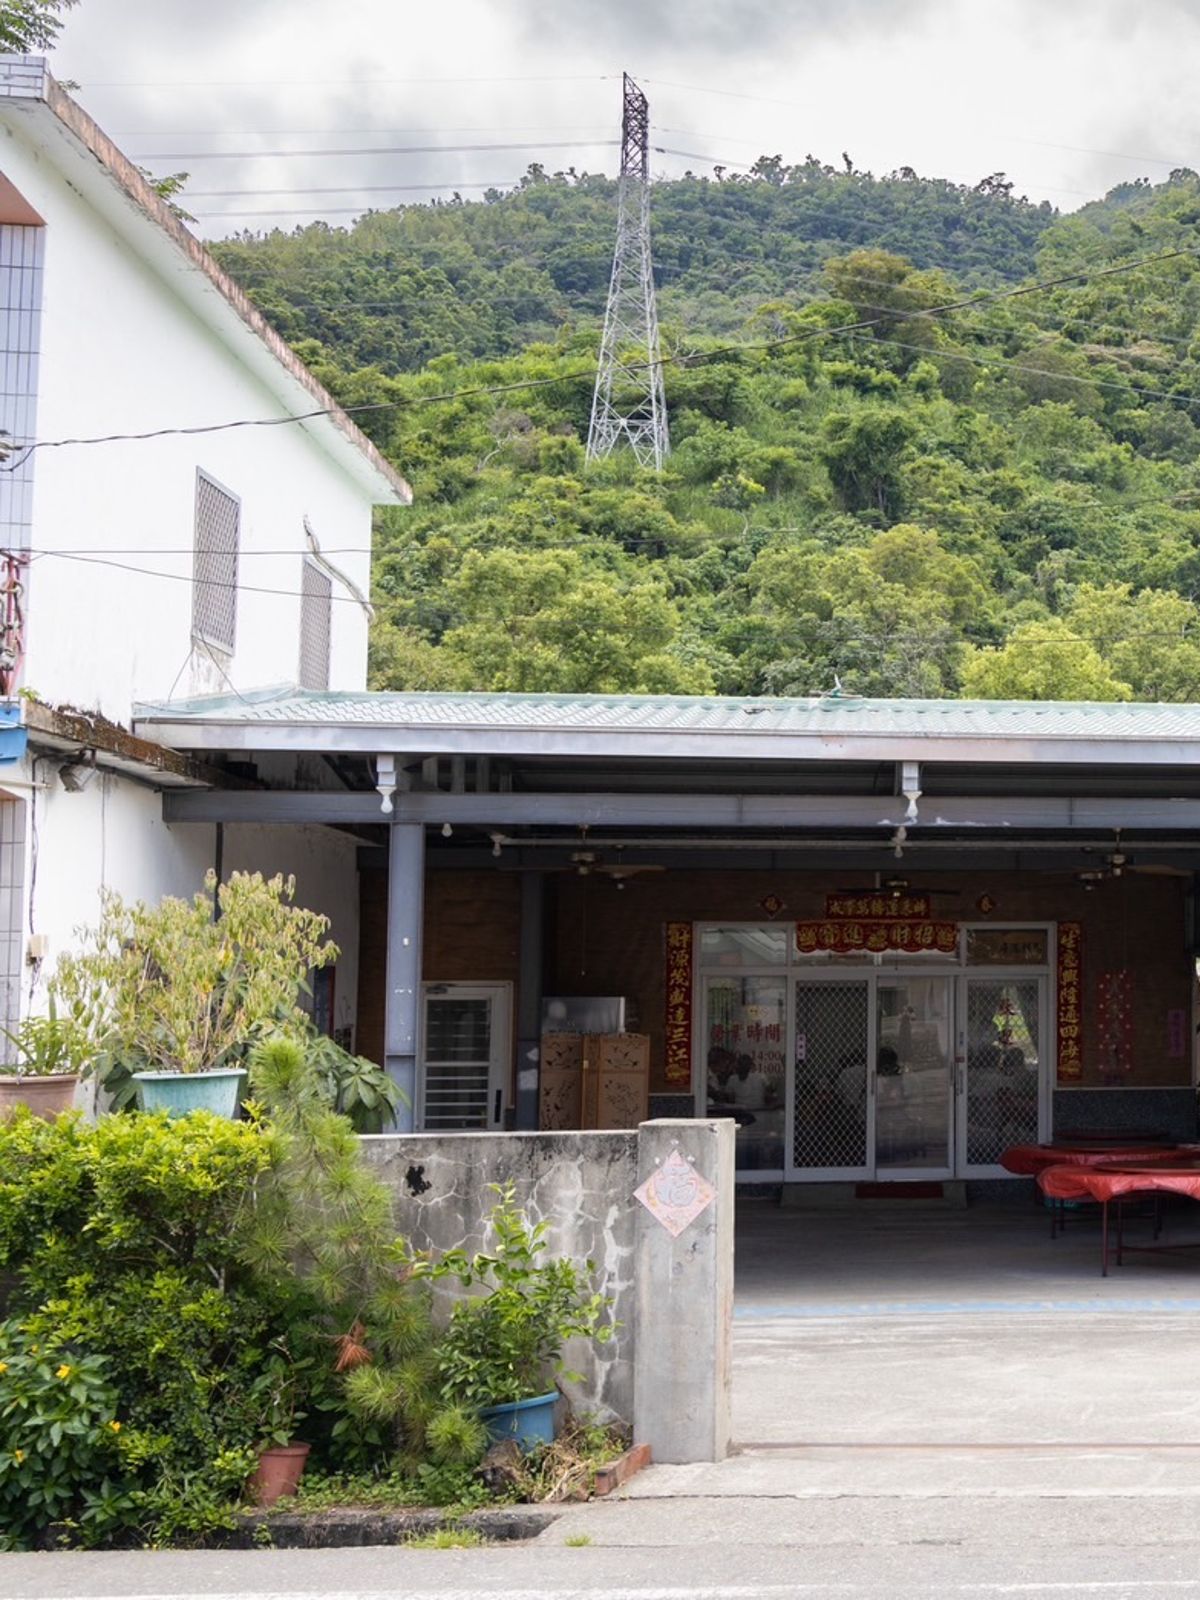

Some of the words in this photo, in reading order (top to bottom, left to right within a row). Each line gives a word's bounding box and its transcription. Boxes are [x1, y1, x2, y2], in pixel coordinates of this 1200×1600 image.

[667, 928, 691, 1063] 財源茂盛達三江
[1059, 929, 1081, 1060] 生意興隆通四海
